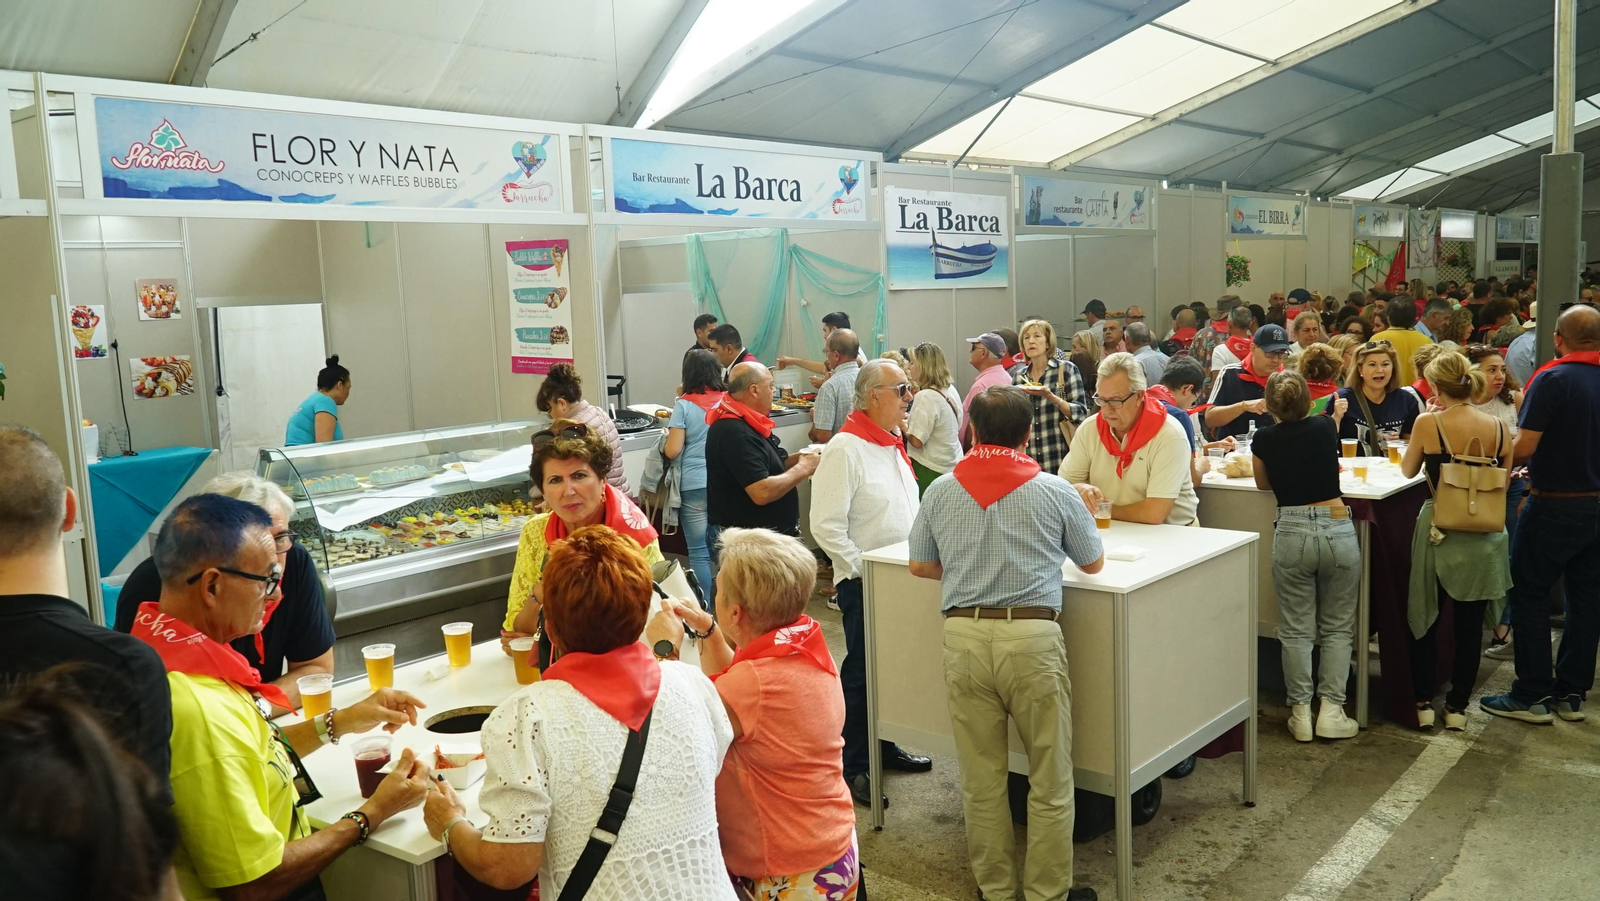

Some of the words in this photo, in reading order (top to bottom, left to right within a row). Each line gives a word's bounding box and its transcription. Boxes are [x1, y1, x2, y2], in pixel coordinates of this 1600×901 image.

[252, 133, 338, 166] FLOR
[348, 139, 366, 168] Y
[379, 142, 460, 173] NATA
[256, 168, 344, 185] CONOCREPS
[347, 173, 355, 184] Y
[358, 174, 410, 188] WAFFLES
[413, 176, 458, 190] BUBBLES
[632, 172, 646, 182] Bar
[647, 173, 691, 185] Restaurante
[694, 163, 726, 199] La
[733, 166, 802, 203] Barca
[898, 196, 910, 204] Bar
[911, 197, 952, 207] Restaurante
[1074, 196, 1083, 205] Bar
[898, 204, 930, 231] La
[936, 206, 1001, 233] Barca
[1053, 205, 1084, 215] restaurante
[1258, 210, 1268, 224] EL
[1268, 210, 1290, 225] BIRRA
